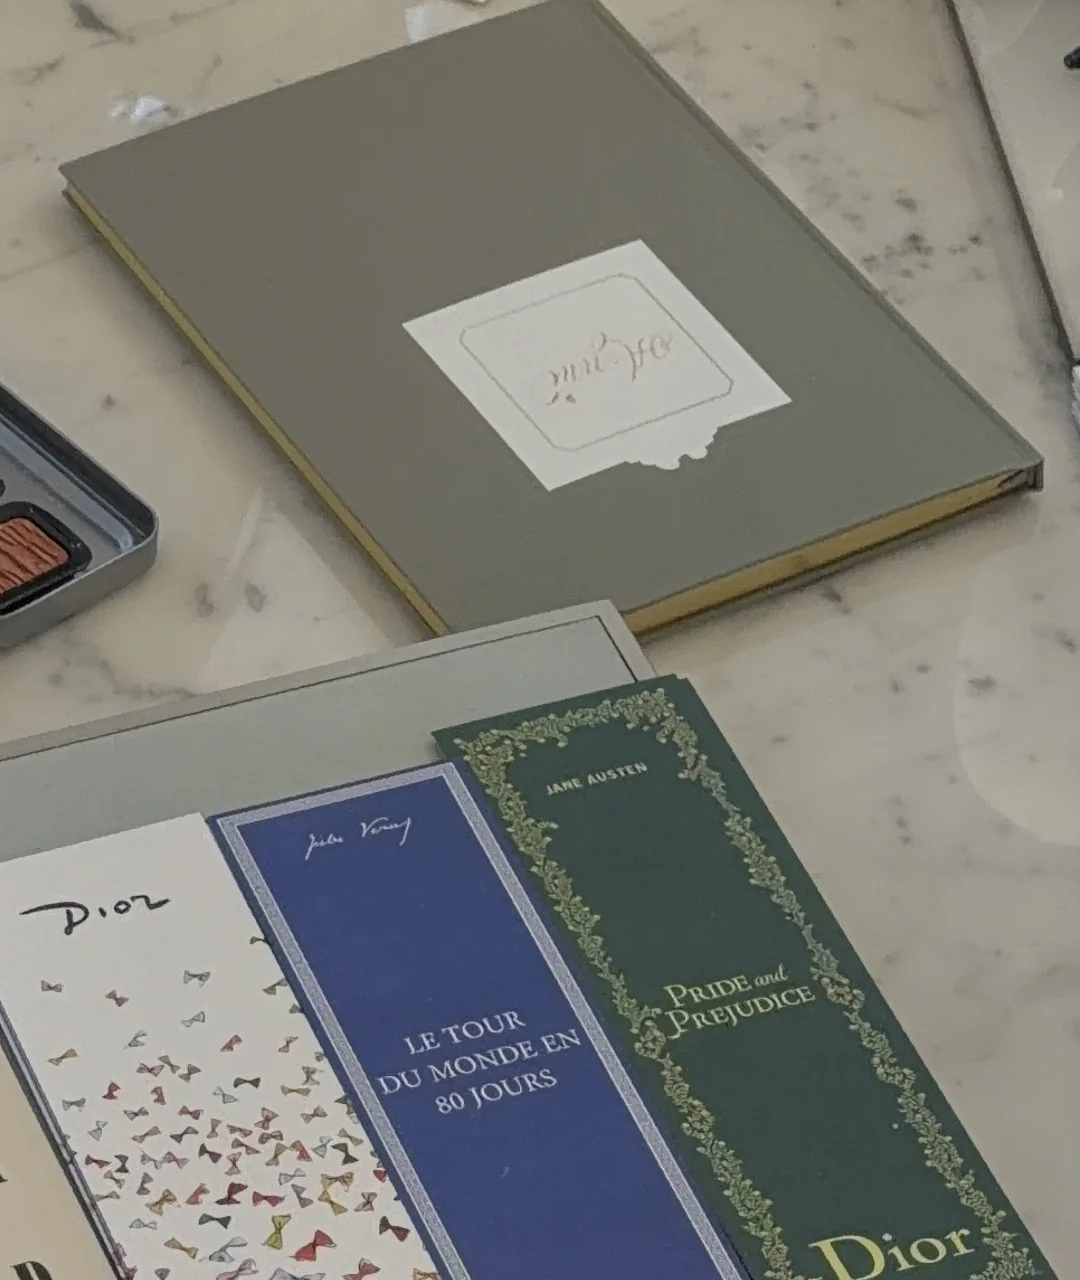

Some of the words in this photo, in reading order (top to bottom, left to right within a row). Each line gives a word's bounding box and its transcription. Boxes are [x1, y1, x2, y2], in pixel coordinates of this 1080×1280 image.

[546, 778, 583, 796] JANE
[587, 761, 648, 785] AUSTEN
[18, 894, 172, 936] Dior
[663, 974, 753, 1008] PRIDE
[754, 963, 789, 987] and
[403, 1031, 441, 1055] LE
[440, 1010, 527, 1044] TOUR
[664, 985, 816, 1040] PREJUDICE
[376, 1068, 422, 1095] DU
[427, 1040, 538, 1083] MONDE
[540, 1028, 582, 1054] EN
[435, 1091, 465, 1114] 80
[469, 1068, 558, 1110] JOURS
